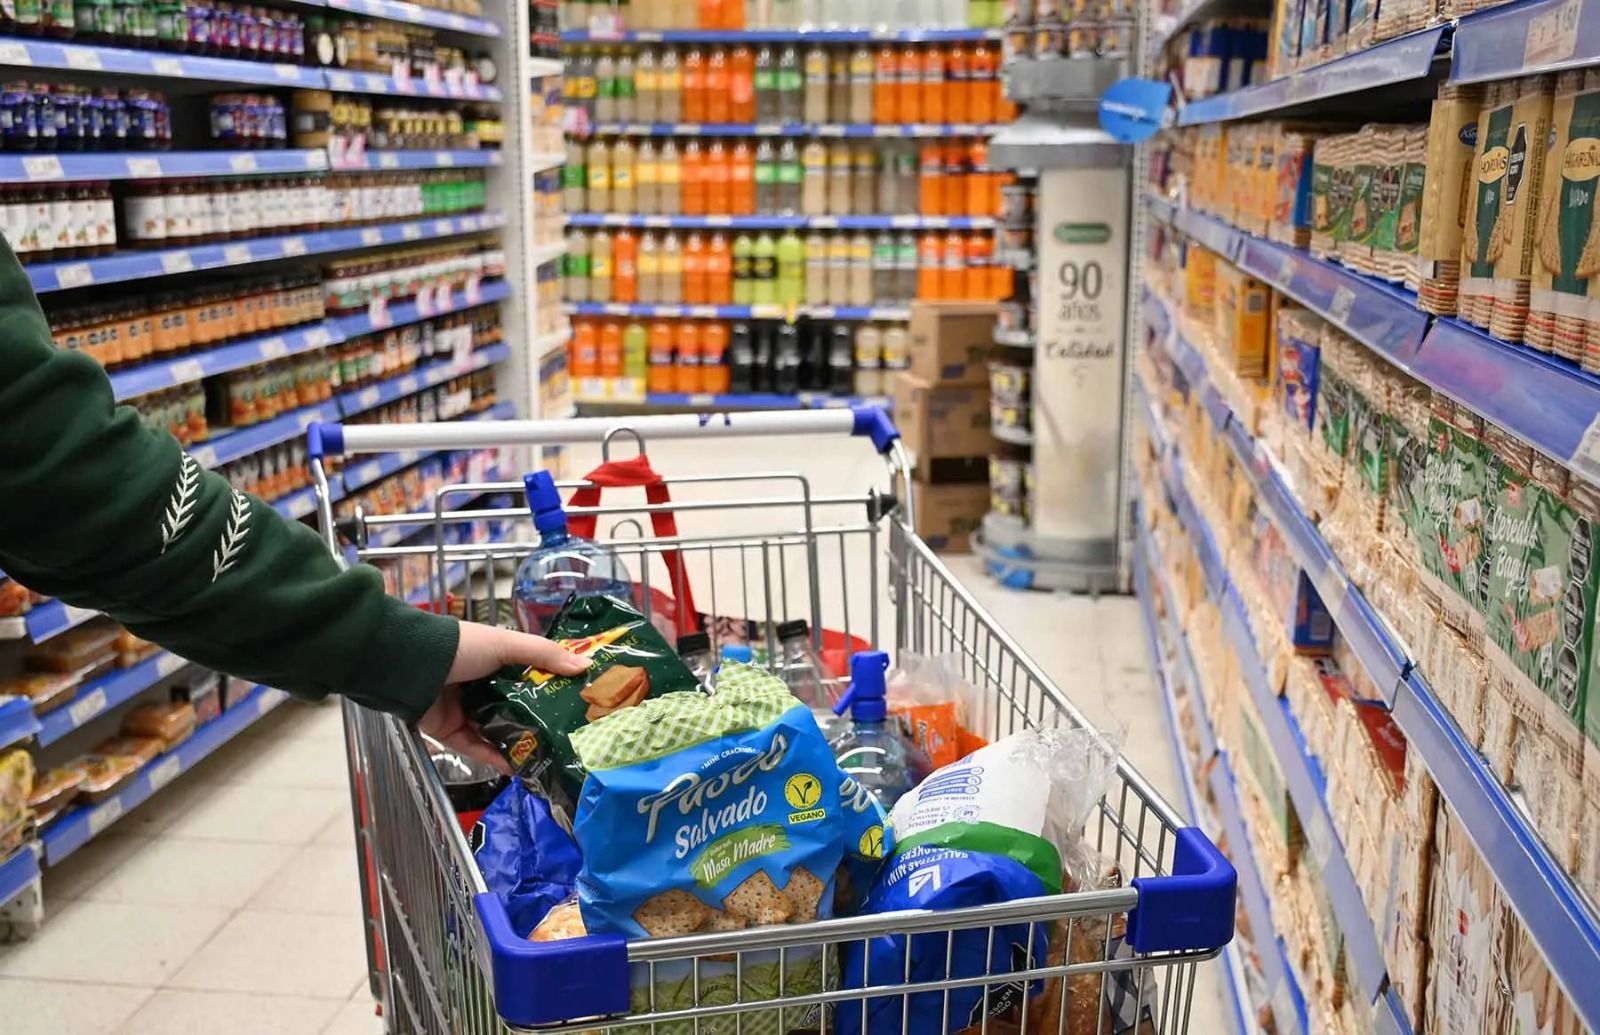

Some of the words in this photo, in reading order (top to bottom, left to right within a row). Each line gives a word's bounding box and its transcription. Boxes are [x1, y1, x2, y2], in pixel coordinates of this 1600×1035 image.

[1059, 261, 1103, 301] 90
[603, 635, 641, 663] SIERE
[703, 754, 720, 769] MINI
[675, 785, 768, 860] Salvado
[789, 810, 825, 823] VEGANO
[703, 857, 731, 883] Masa
[734, 831, 777, 863] Madre
